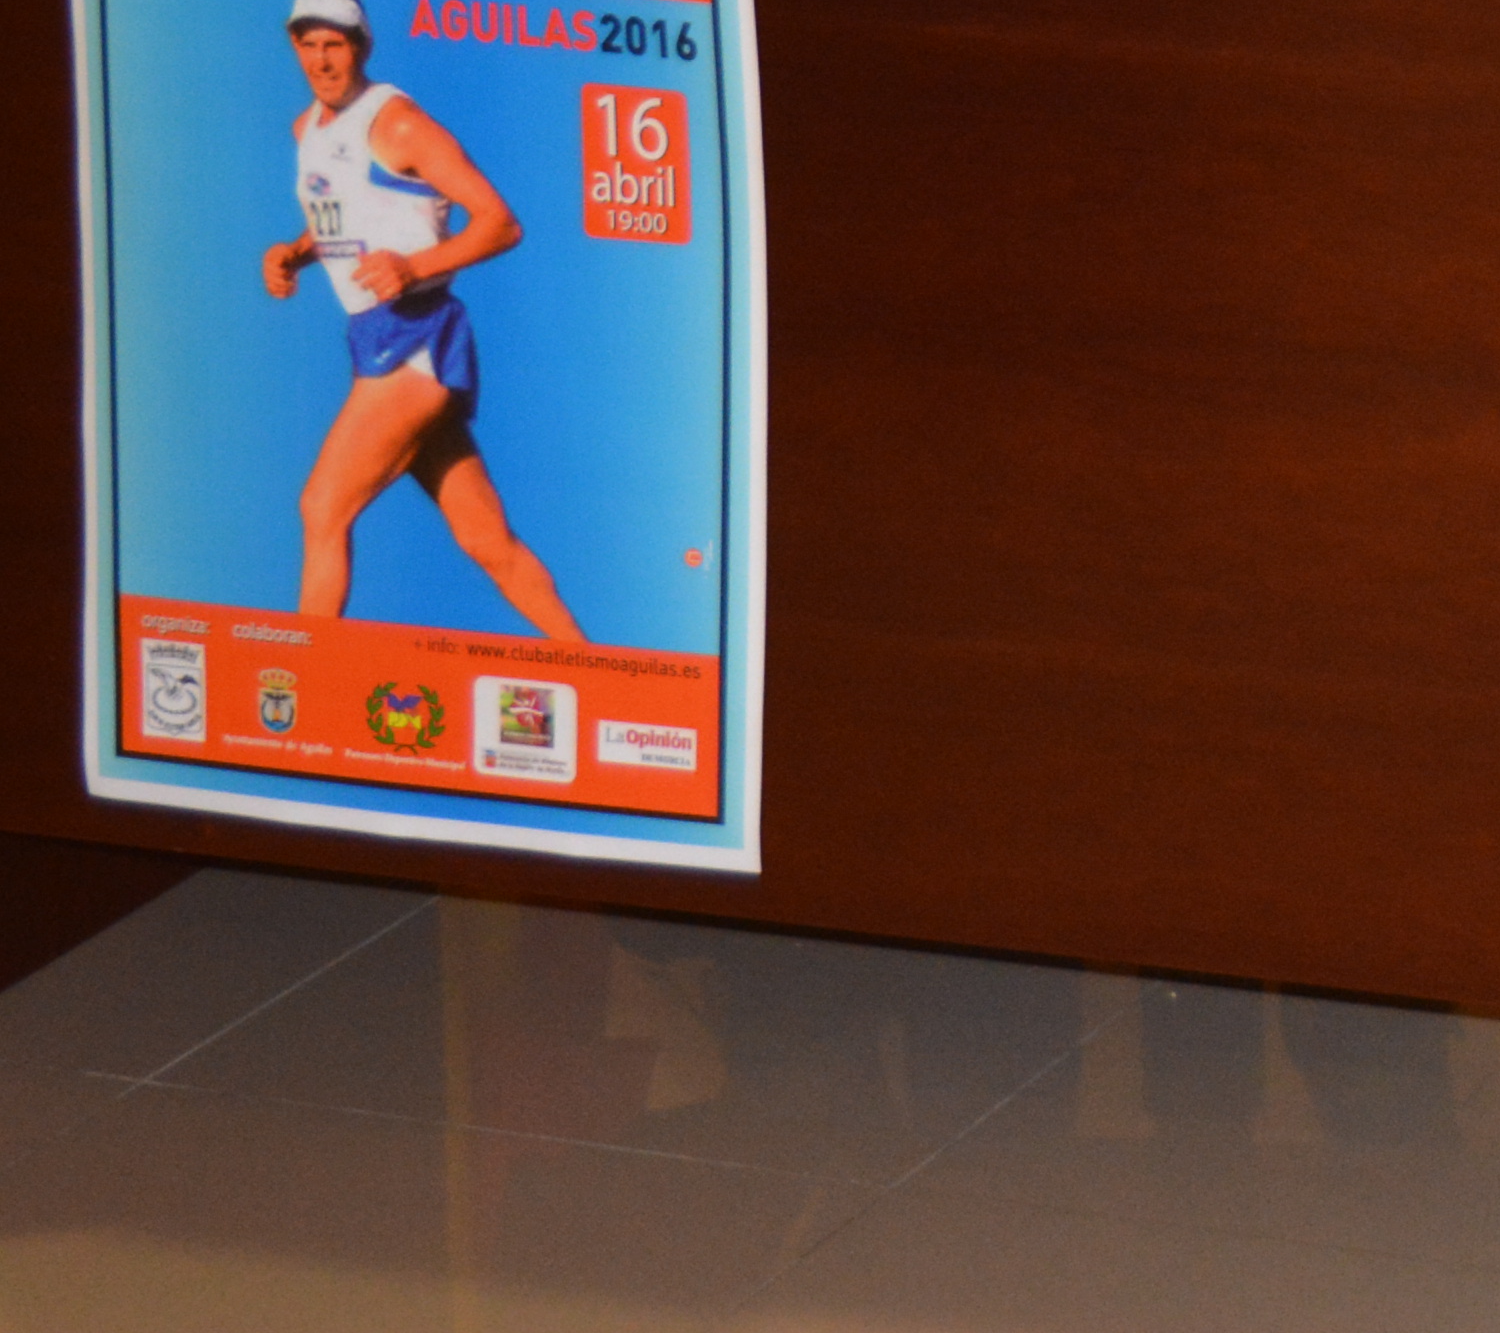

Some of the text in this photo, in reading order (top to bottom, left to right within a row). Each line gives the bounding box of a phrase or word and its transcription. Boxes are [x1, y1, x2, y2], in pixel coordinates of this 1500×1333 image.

[596, 93, 670, 161] 16
[591, 162, 676, 208] abril
[606, 208, 668, 235] 19:00
[142, 613, 312, 646] organiza: colaboran:
[467, 642, 701, 679] www.clubatletismoaguilas.es
